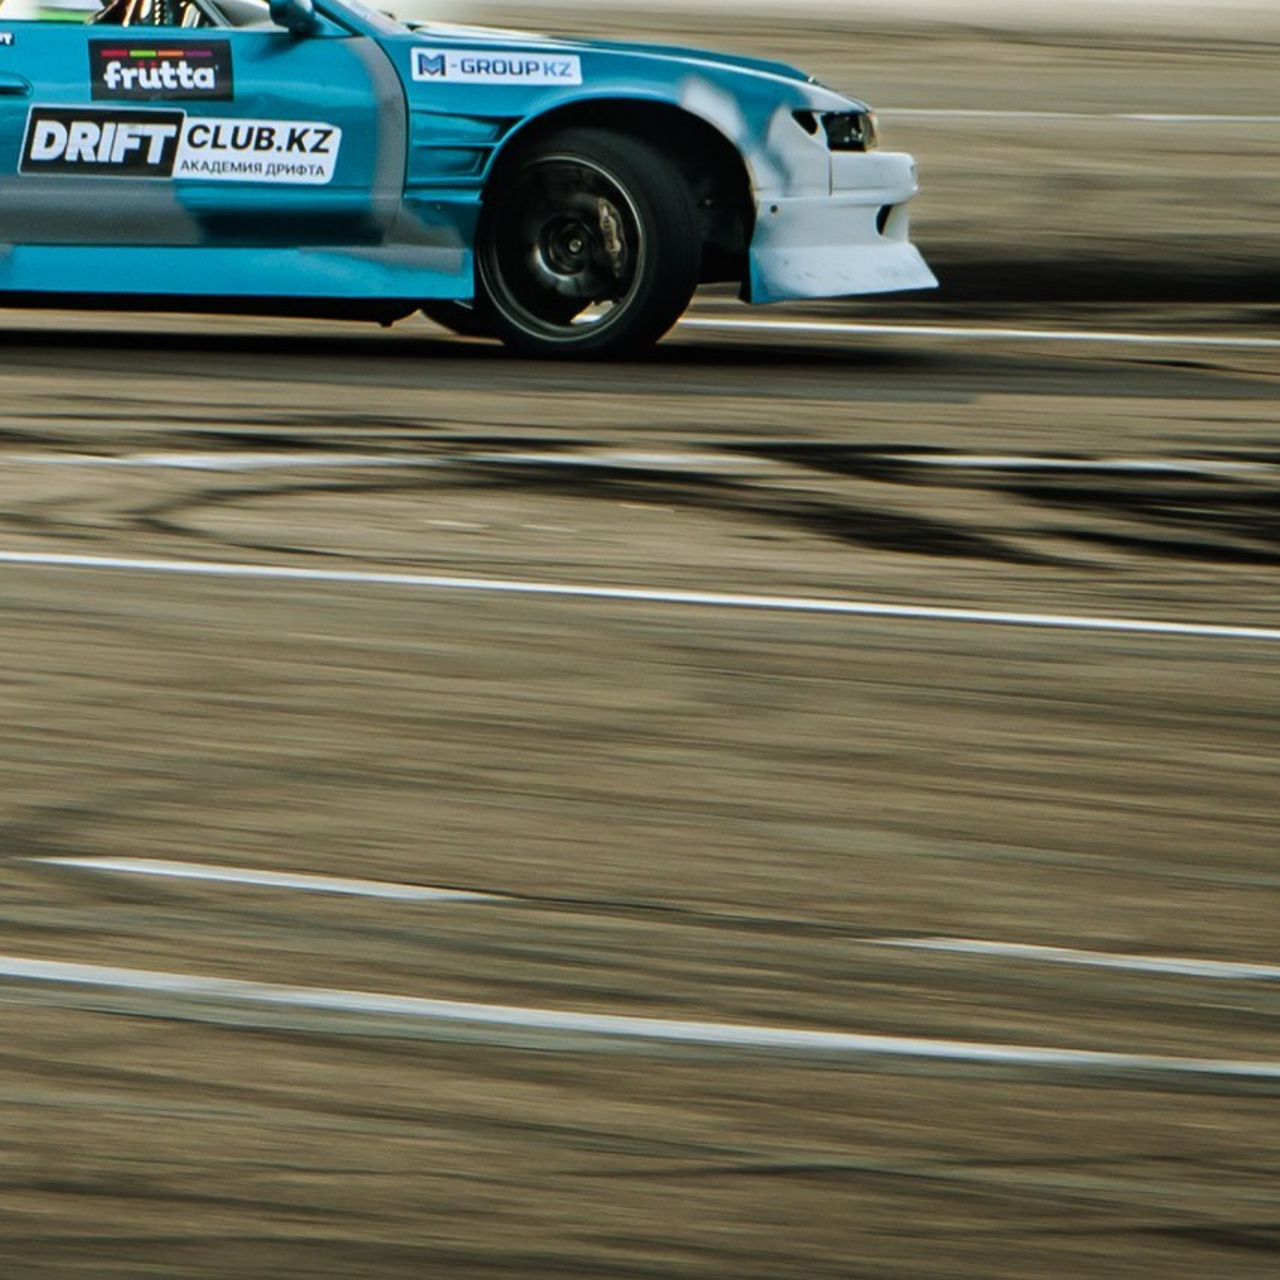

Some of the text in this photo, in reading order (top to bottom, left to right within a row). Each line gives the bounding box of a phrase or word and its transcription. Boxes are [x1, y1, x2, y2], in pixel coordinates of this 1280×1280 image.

[30, 120, 334, 164] DRIFT CLUB.KZ
[180, 159, 326, 177] АКАДЕМИЯ ДРИФТА
